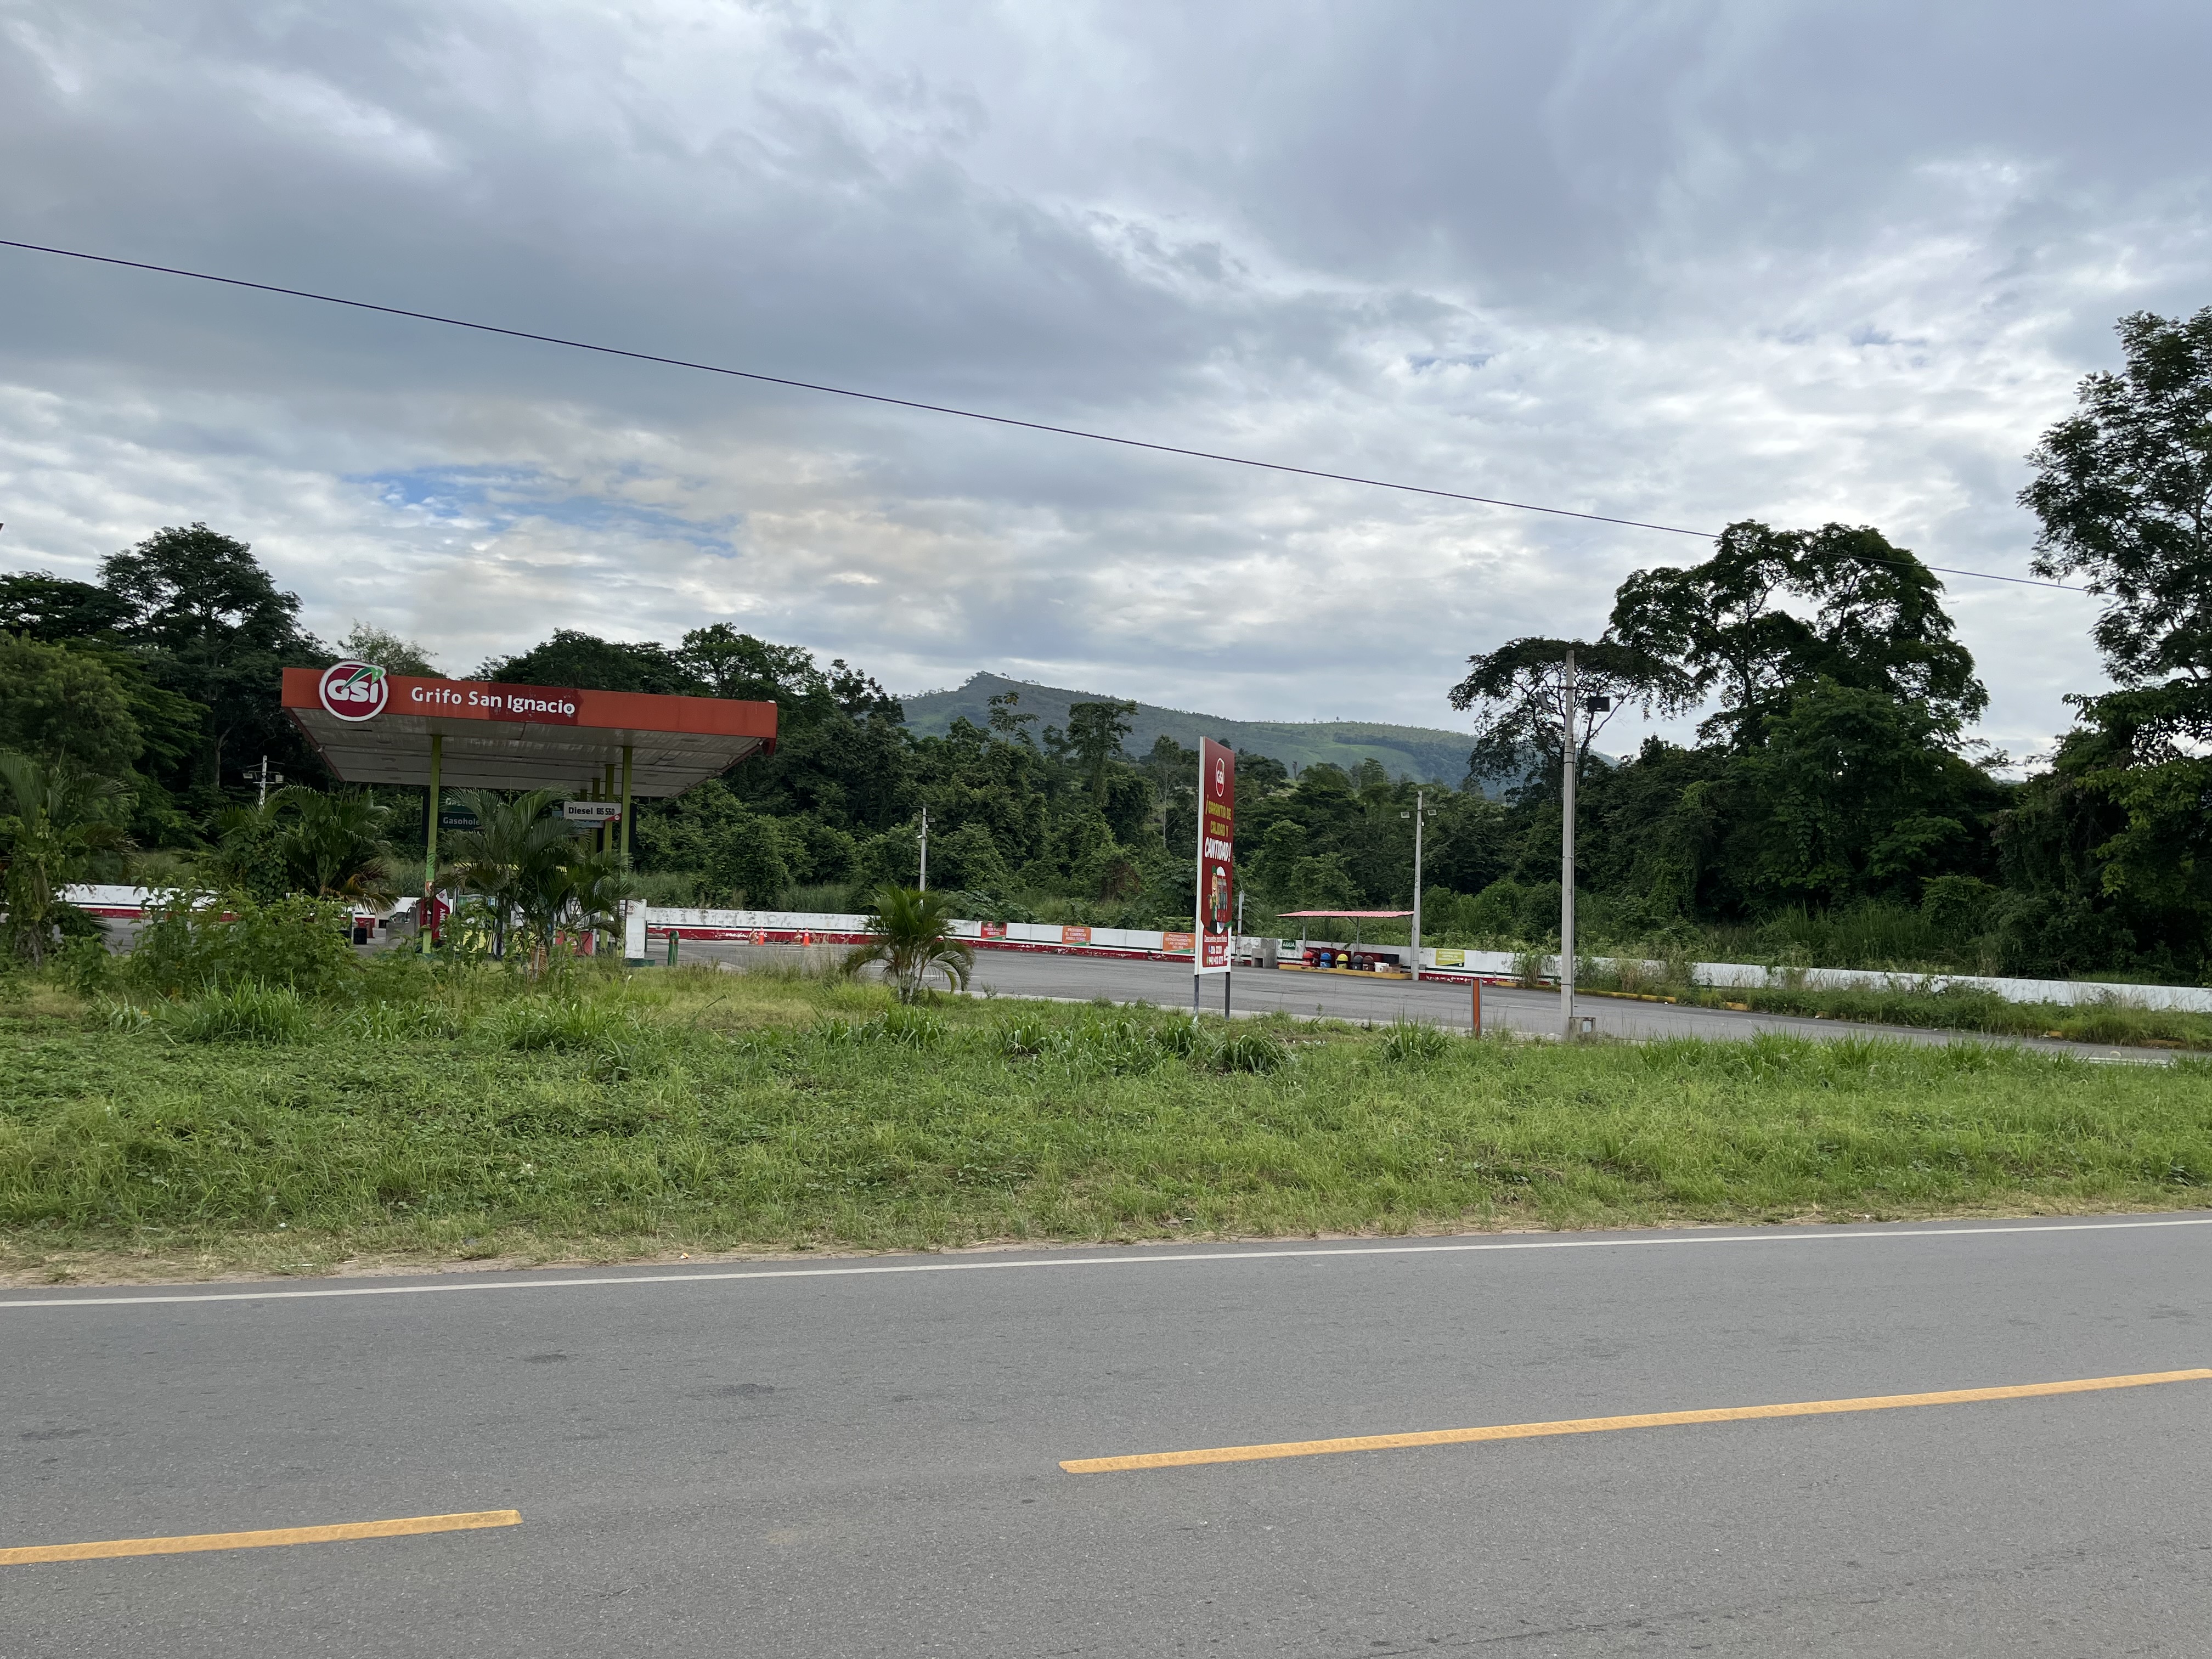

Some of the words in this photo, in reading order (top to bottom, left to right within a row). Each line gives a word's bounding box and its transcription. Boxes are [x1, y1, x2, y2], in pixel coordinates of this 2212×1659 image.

[327, 679, 379, 703] GSI
[411, 687, 462, 704] Grifo
[468, 691, 501, 707] San
[507, 695, 575, 714] Ignacio
[568, 804, 593, 815] Diesel
[1226, 825, 1229, 838] Y
[1205, 837, 1232, 863] CANTIDAD!
